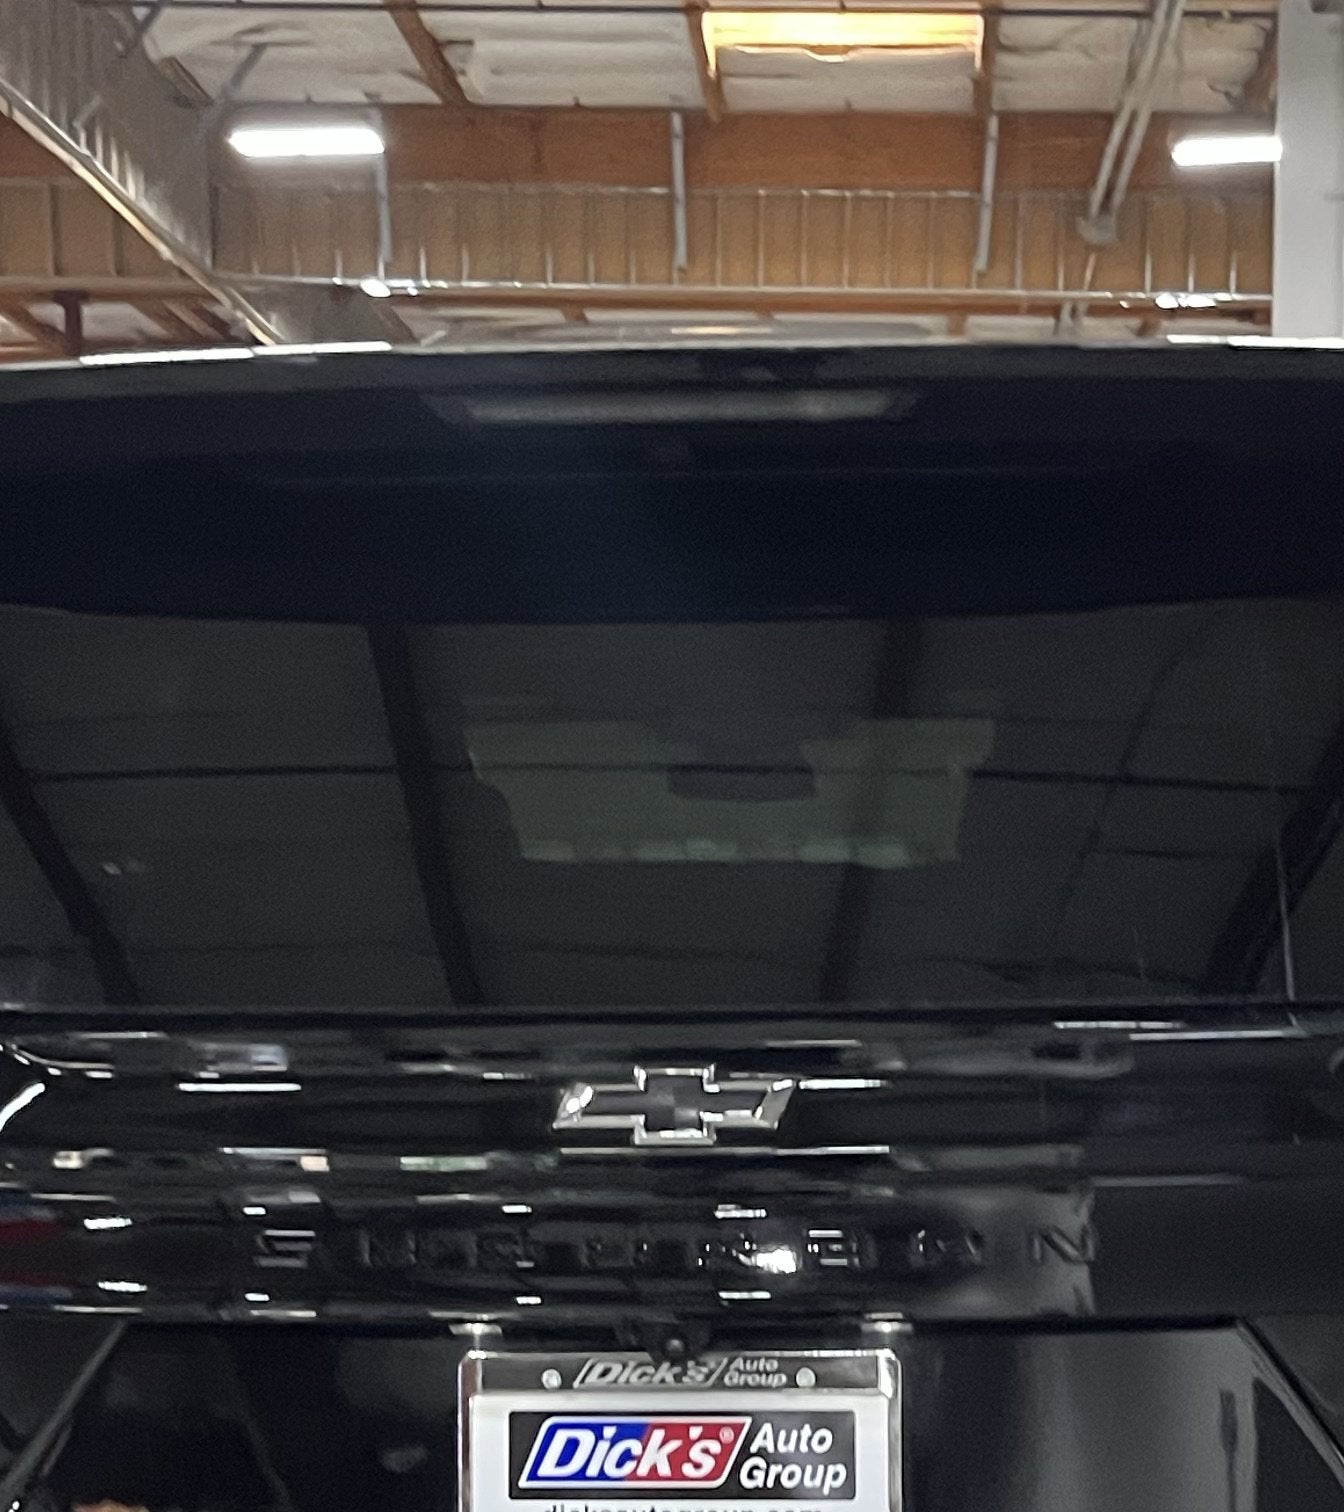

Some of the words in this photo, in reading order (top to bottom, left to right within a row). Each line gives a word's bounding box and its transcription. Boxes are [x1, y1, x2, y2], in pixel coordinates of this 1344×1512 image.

[723, 1371, 788, 1388] Group
[729, 1356, 780, 1372] Auto
[536, 1424, 724, 1479] Dick's
[750, 1423, 833, 1454] Auto
[739, 1456, 848, 1494] Group
